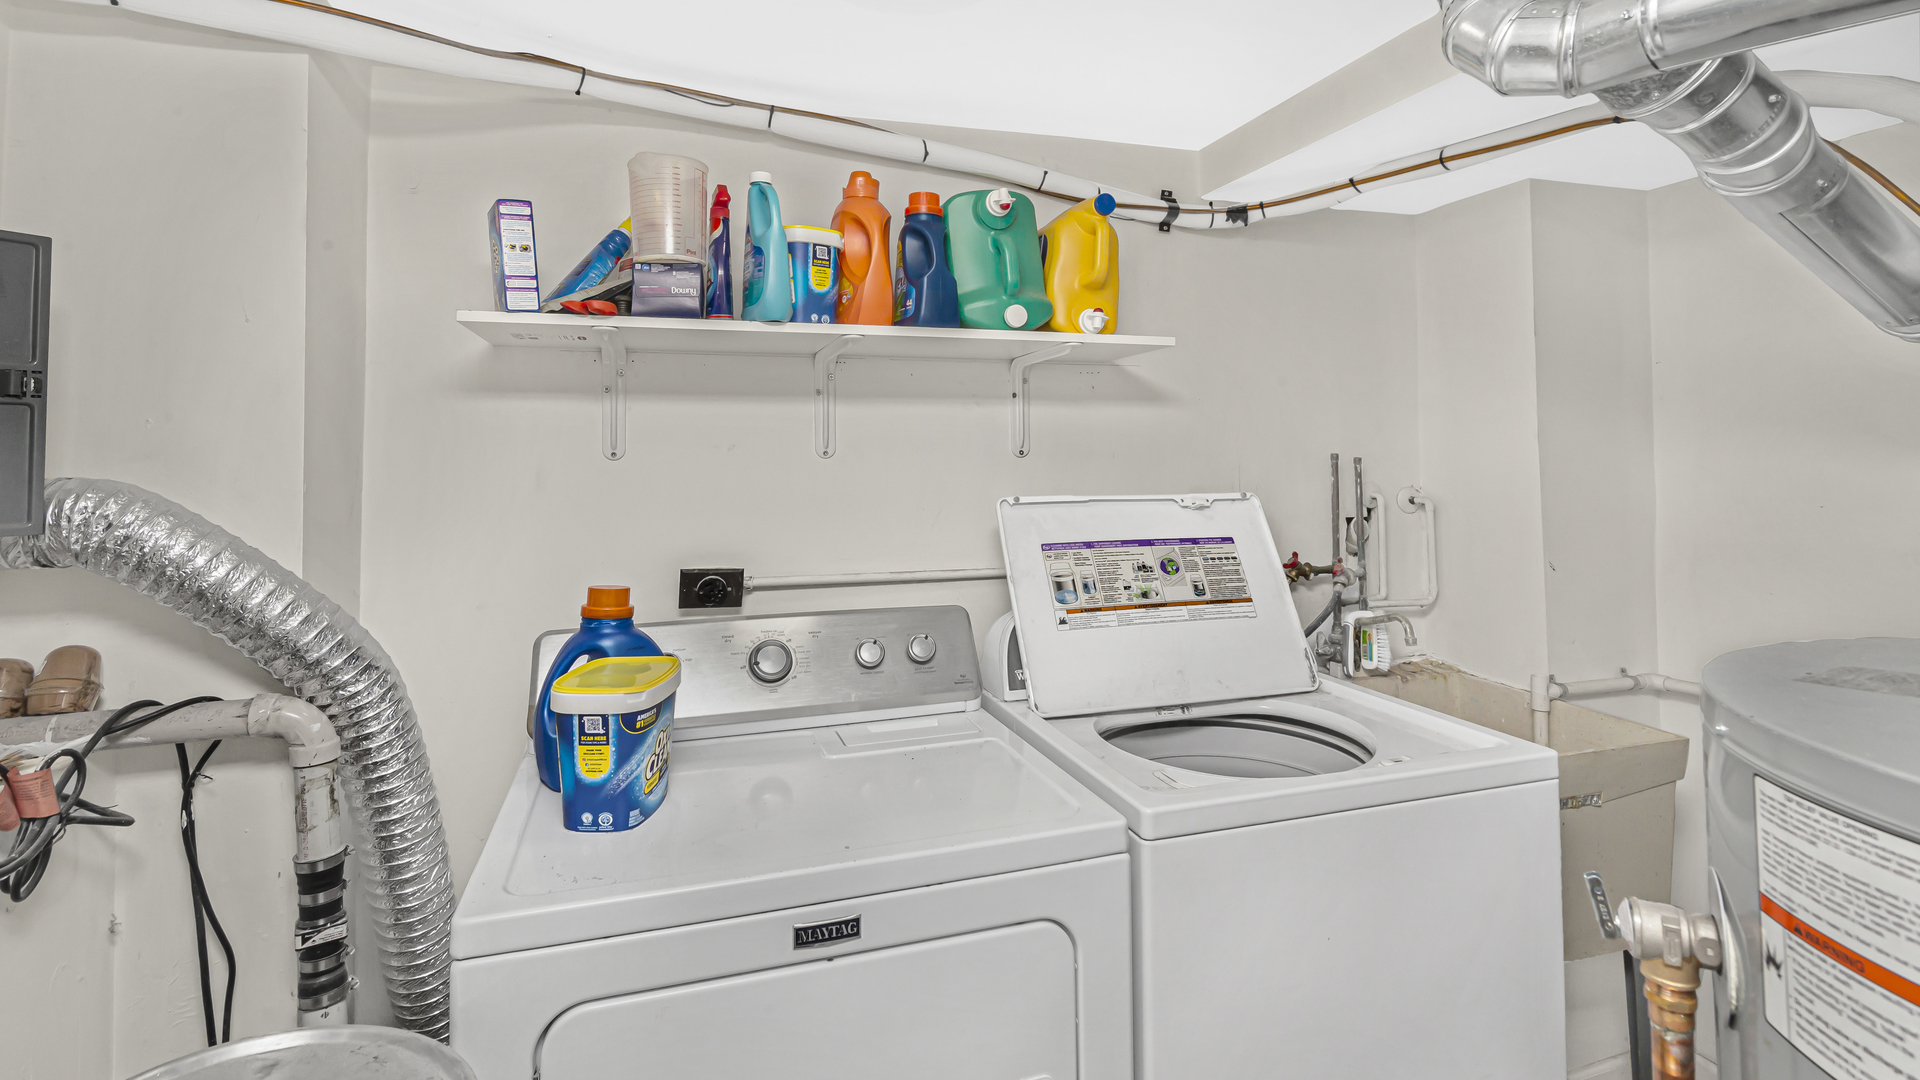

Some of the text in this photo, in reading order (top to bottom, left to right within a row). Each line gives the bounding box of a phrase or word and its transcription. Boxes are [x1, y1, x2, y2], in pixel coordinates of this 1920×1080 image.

[671, 286, 697, 296] Downy
[797, 922, 858, 943] MAYTAG
[1804, 931, 1866, 974] WARNING
